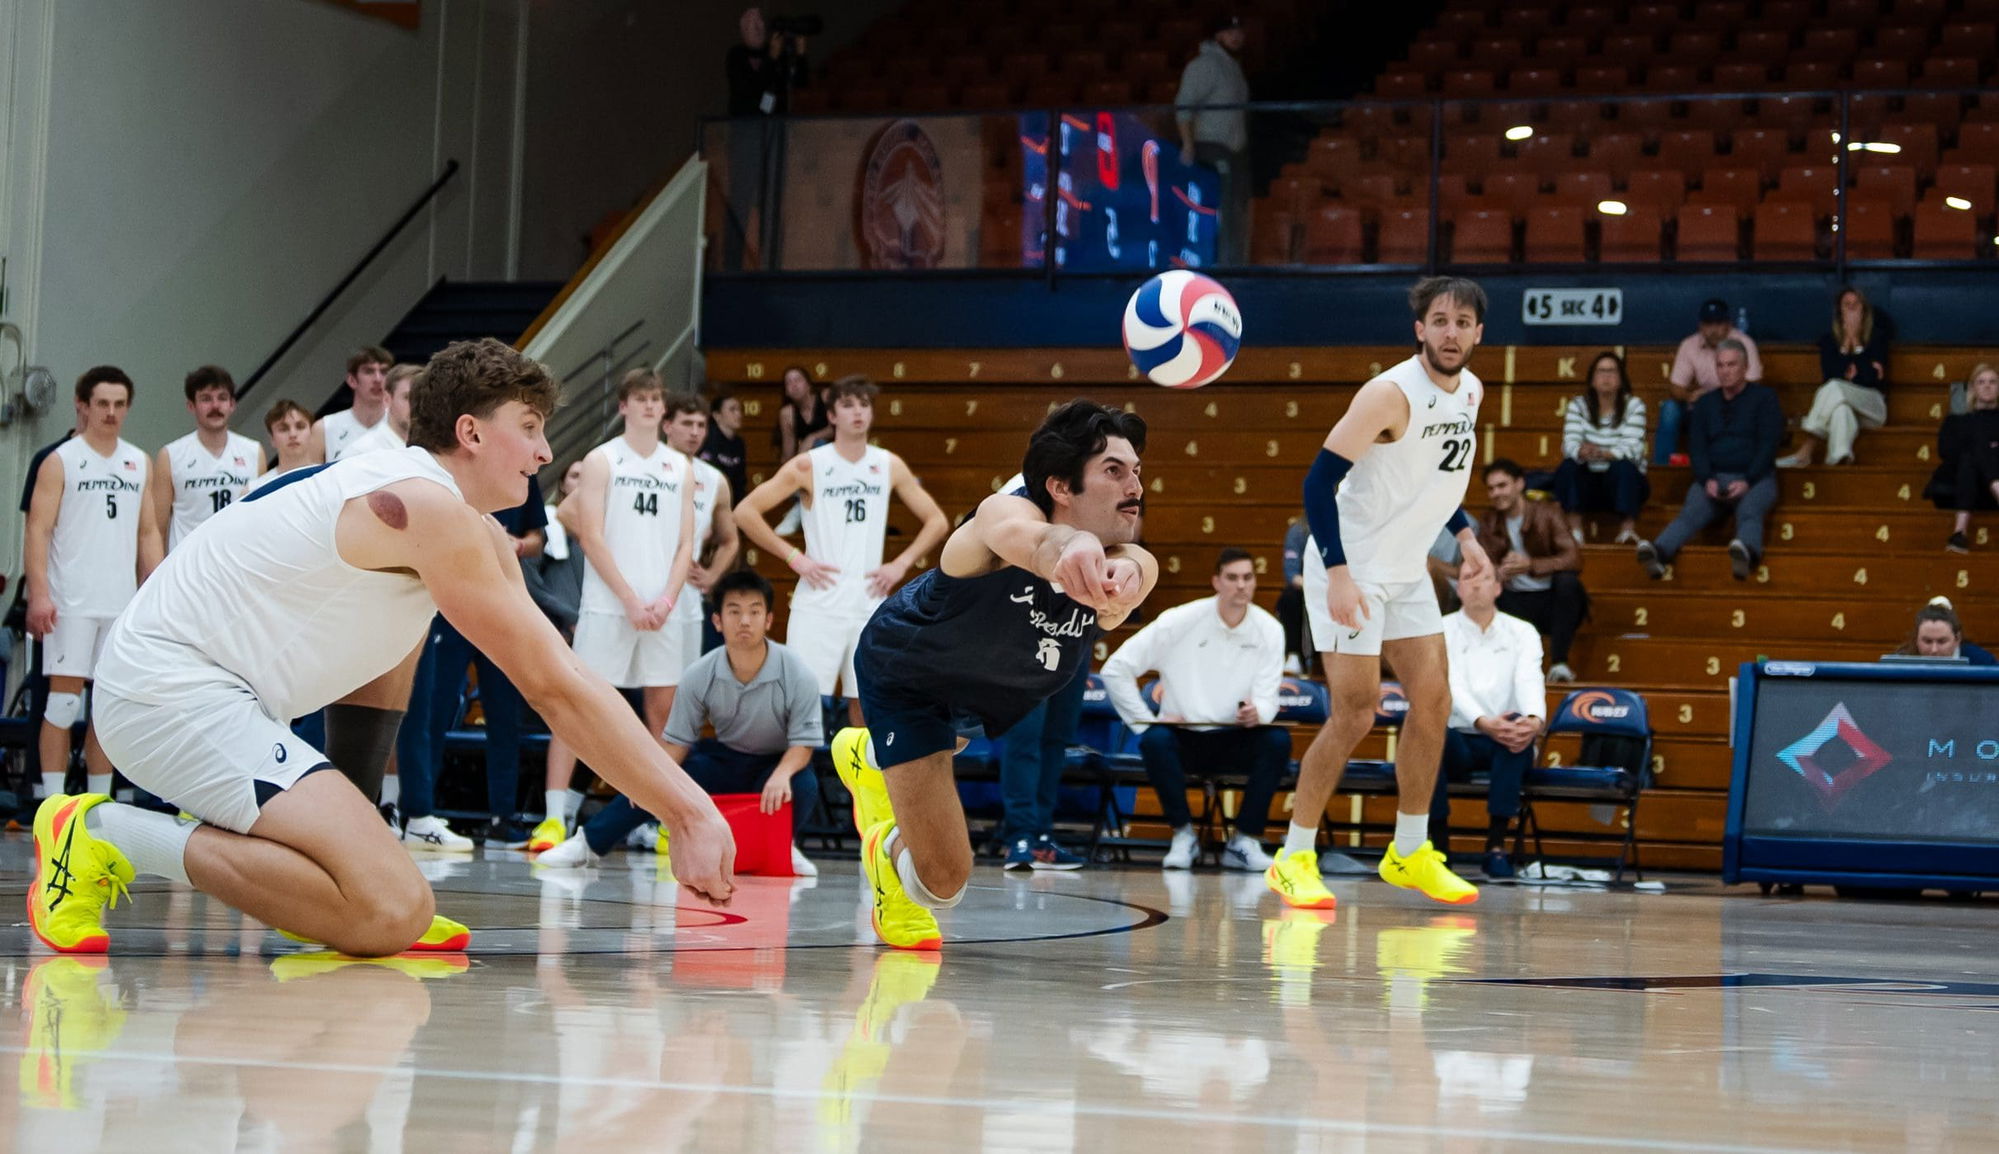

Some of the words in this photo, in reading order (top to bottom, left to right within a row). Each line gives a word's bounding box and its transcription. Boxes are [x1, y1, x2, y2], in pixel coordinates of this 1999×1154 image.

[1540, 295, 1552, 319] 5
[1561, 299, 1586, 316] SEC
[1592, 294, 1605, 319] 4
[746, 363, 764, 379] 10
[968, 362, 981, 378] 7
[1289, 362, 1302, 379] 3
[1557, 357, 1577, 377] K
[1932, 363, 1946, 379] 4
[744, 400, 762, 416] 10
[966, 400, 978, 416] 7
[1204, 402, 1218, 418] 4
[1286, 401, 1299, 418] 3
[1929, 403, 1942, 419] 4
[945, 438, 957, 454] 7
[1185, 440, 1198, 456] 4
[1266, 440, 1279, 457] 3
[1438, 438, 1471, 472] 22
[1916, 445, 1930, 461] 4
[77, 473, 140, 492] PEPPERDINE
[184, 471, 249, 490] PEPPERDINE
[615, 473, 678, 493] PEPPERDINE
[822, 479, 881, 498] PEPPERDINE
[1150, 477, 1164, 493] 4
[1234, 477, 1247, 494] 3
[1803, 482, 1816, 499] 3
[1897, 484, 1911, 501] 4
[106, 494, 117, 519] 5
[633, 491, 658, 517] 44
[845, 499, 866, 523] 26
[1202, 516, 1215, 534] 3
[1781, 523, 1794, 540] 3
[1875, 525, 1890, 542] 4
[1976, 527, 1989, 544] 5
[1168, 556, 1181, 574] 3
[1256, 556, 1268, 574] 2
[1756, 565, 1770, 583] 3
[1853, 568, 1868, 585] 4
[1956, 569, 1969, 588] 5
[1635, 607, 1648, 626] 2
[1731, 609, 1745, 628] 3
[1830, 612, 1845, 630] 4
[1094, 642, 1108, 661] 3
[1607, 654, 1621, 673] 2
[1706, 656, 1721, 676] 3
[1678, 704, 1693, 724] 3
[1651, 755, 1665, 774] 3
